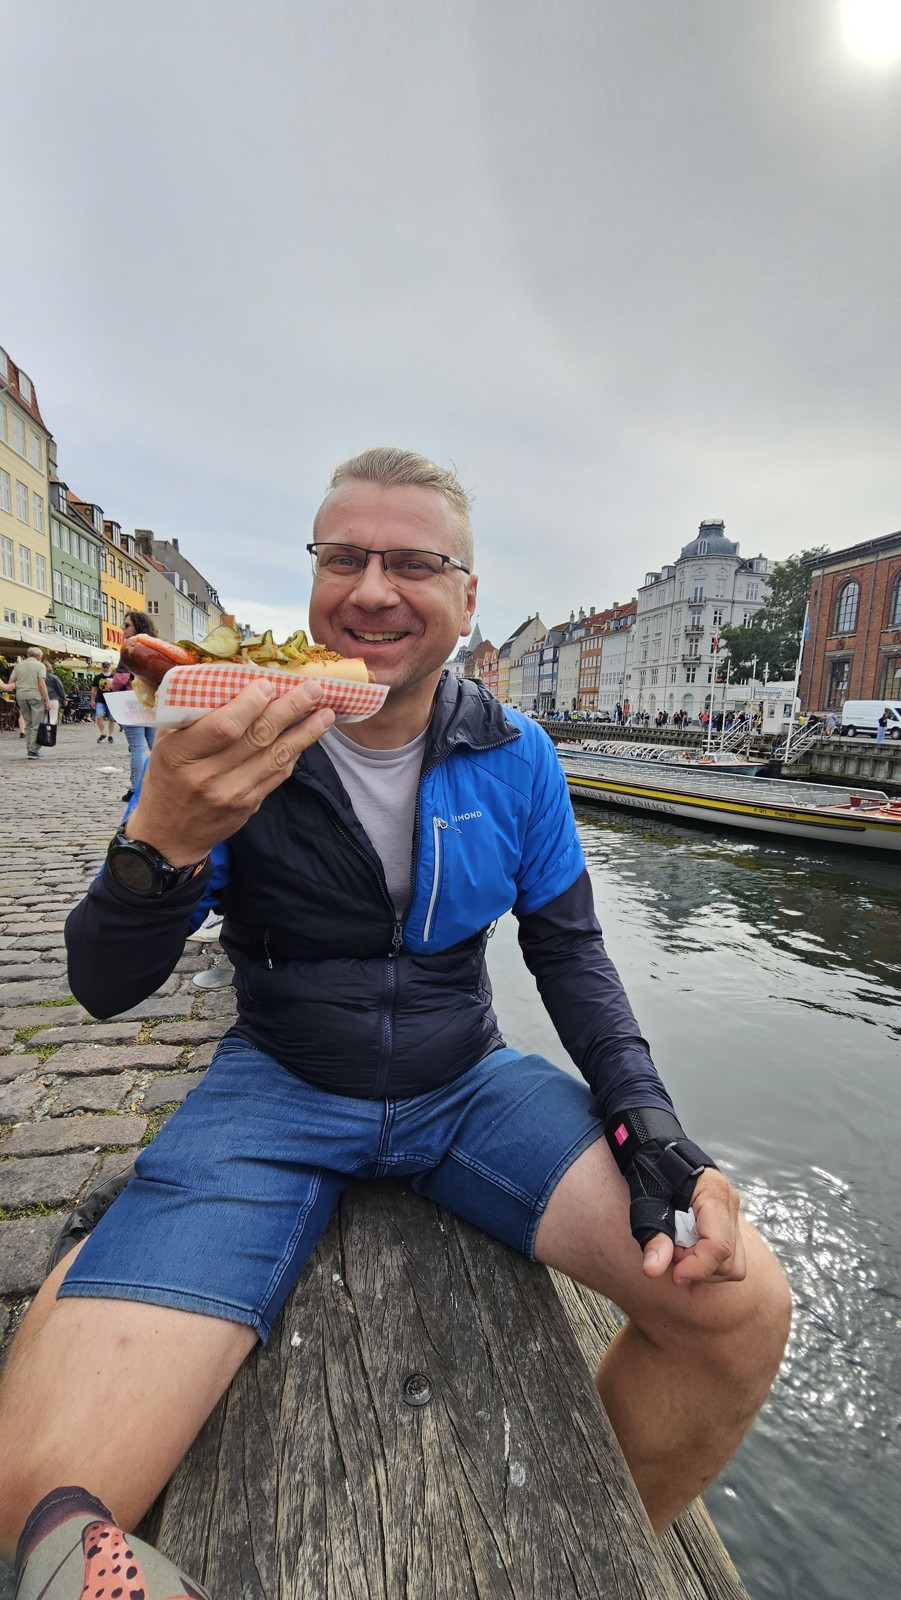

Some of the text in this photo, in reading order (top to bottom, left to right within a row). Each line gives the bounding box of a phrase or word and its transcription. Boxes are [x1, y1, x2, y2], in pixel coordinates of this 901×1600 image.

[64, 609, 91, 629] HEERING
[106, 627, 124, 645] NYH
[584, 789, 608, 800] TOURS
[615, 796, 676, 813] COPENHAGEN
